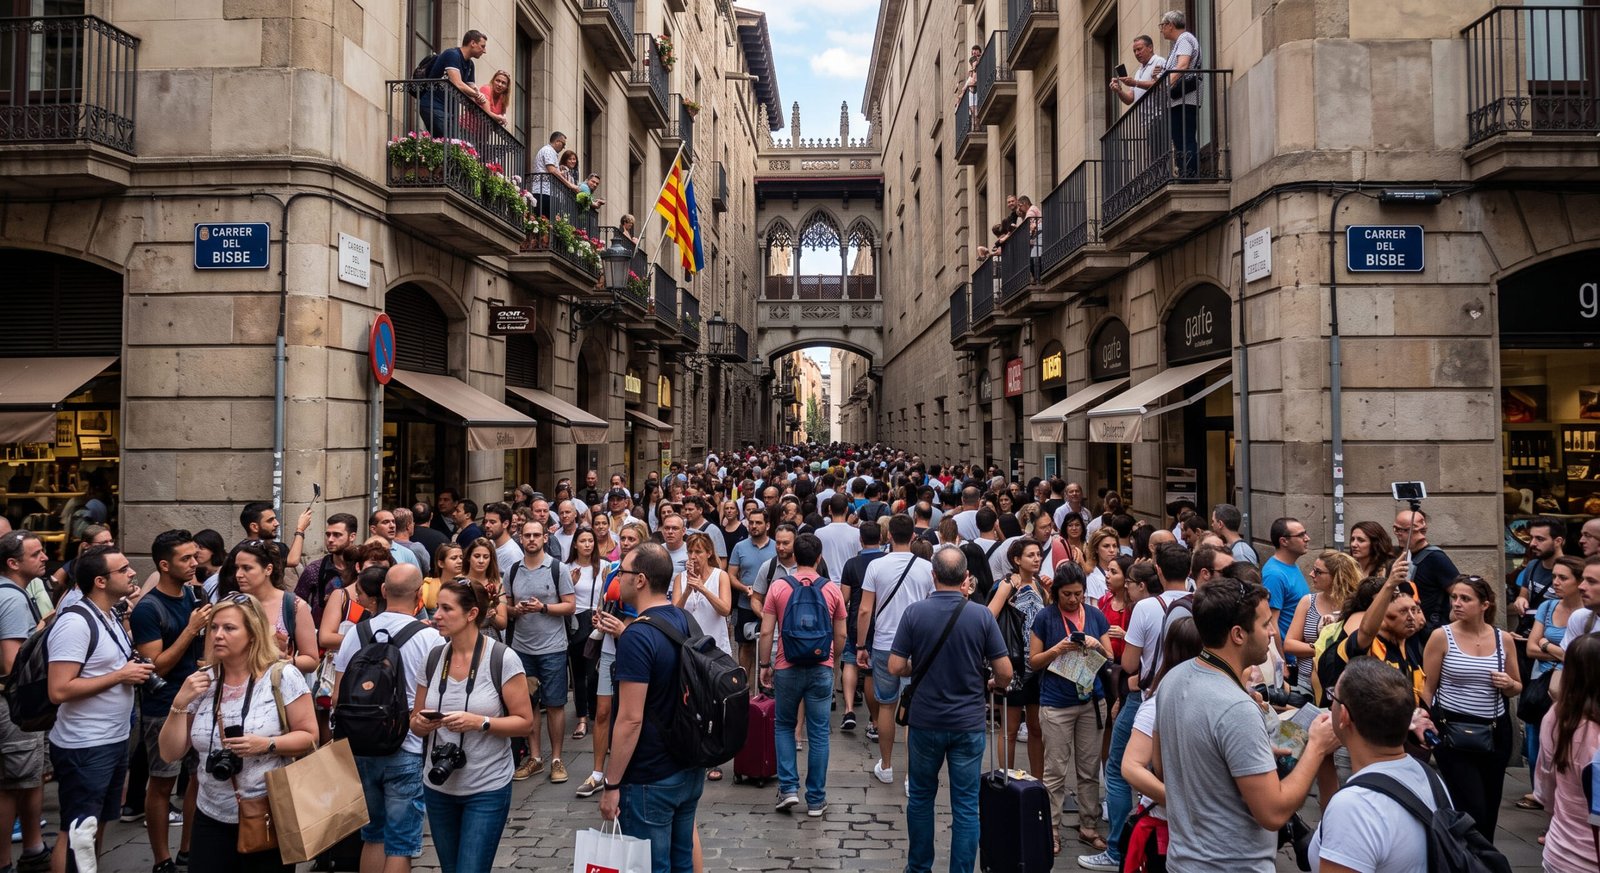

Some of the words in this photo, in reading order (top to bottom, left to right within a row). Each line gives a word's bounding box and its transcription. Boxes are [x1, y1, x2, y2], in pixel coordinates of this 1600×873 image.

[212, 227, 252, 237] CARRER
[1365, 229, 1406, 239] CARRER
[223, 239, 240, 248] DEL
[1376, 242, 1395, 251] DEL
[212, 251, 250, 263] BISBE
[1366, 254, 1405, 266] BISBE
